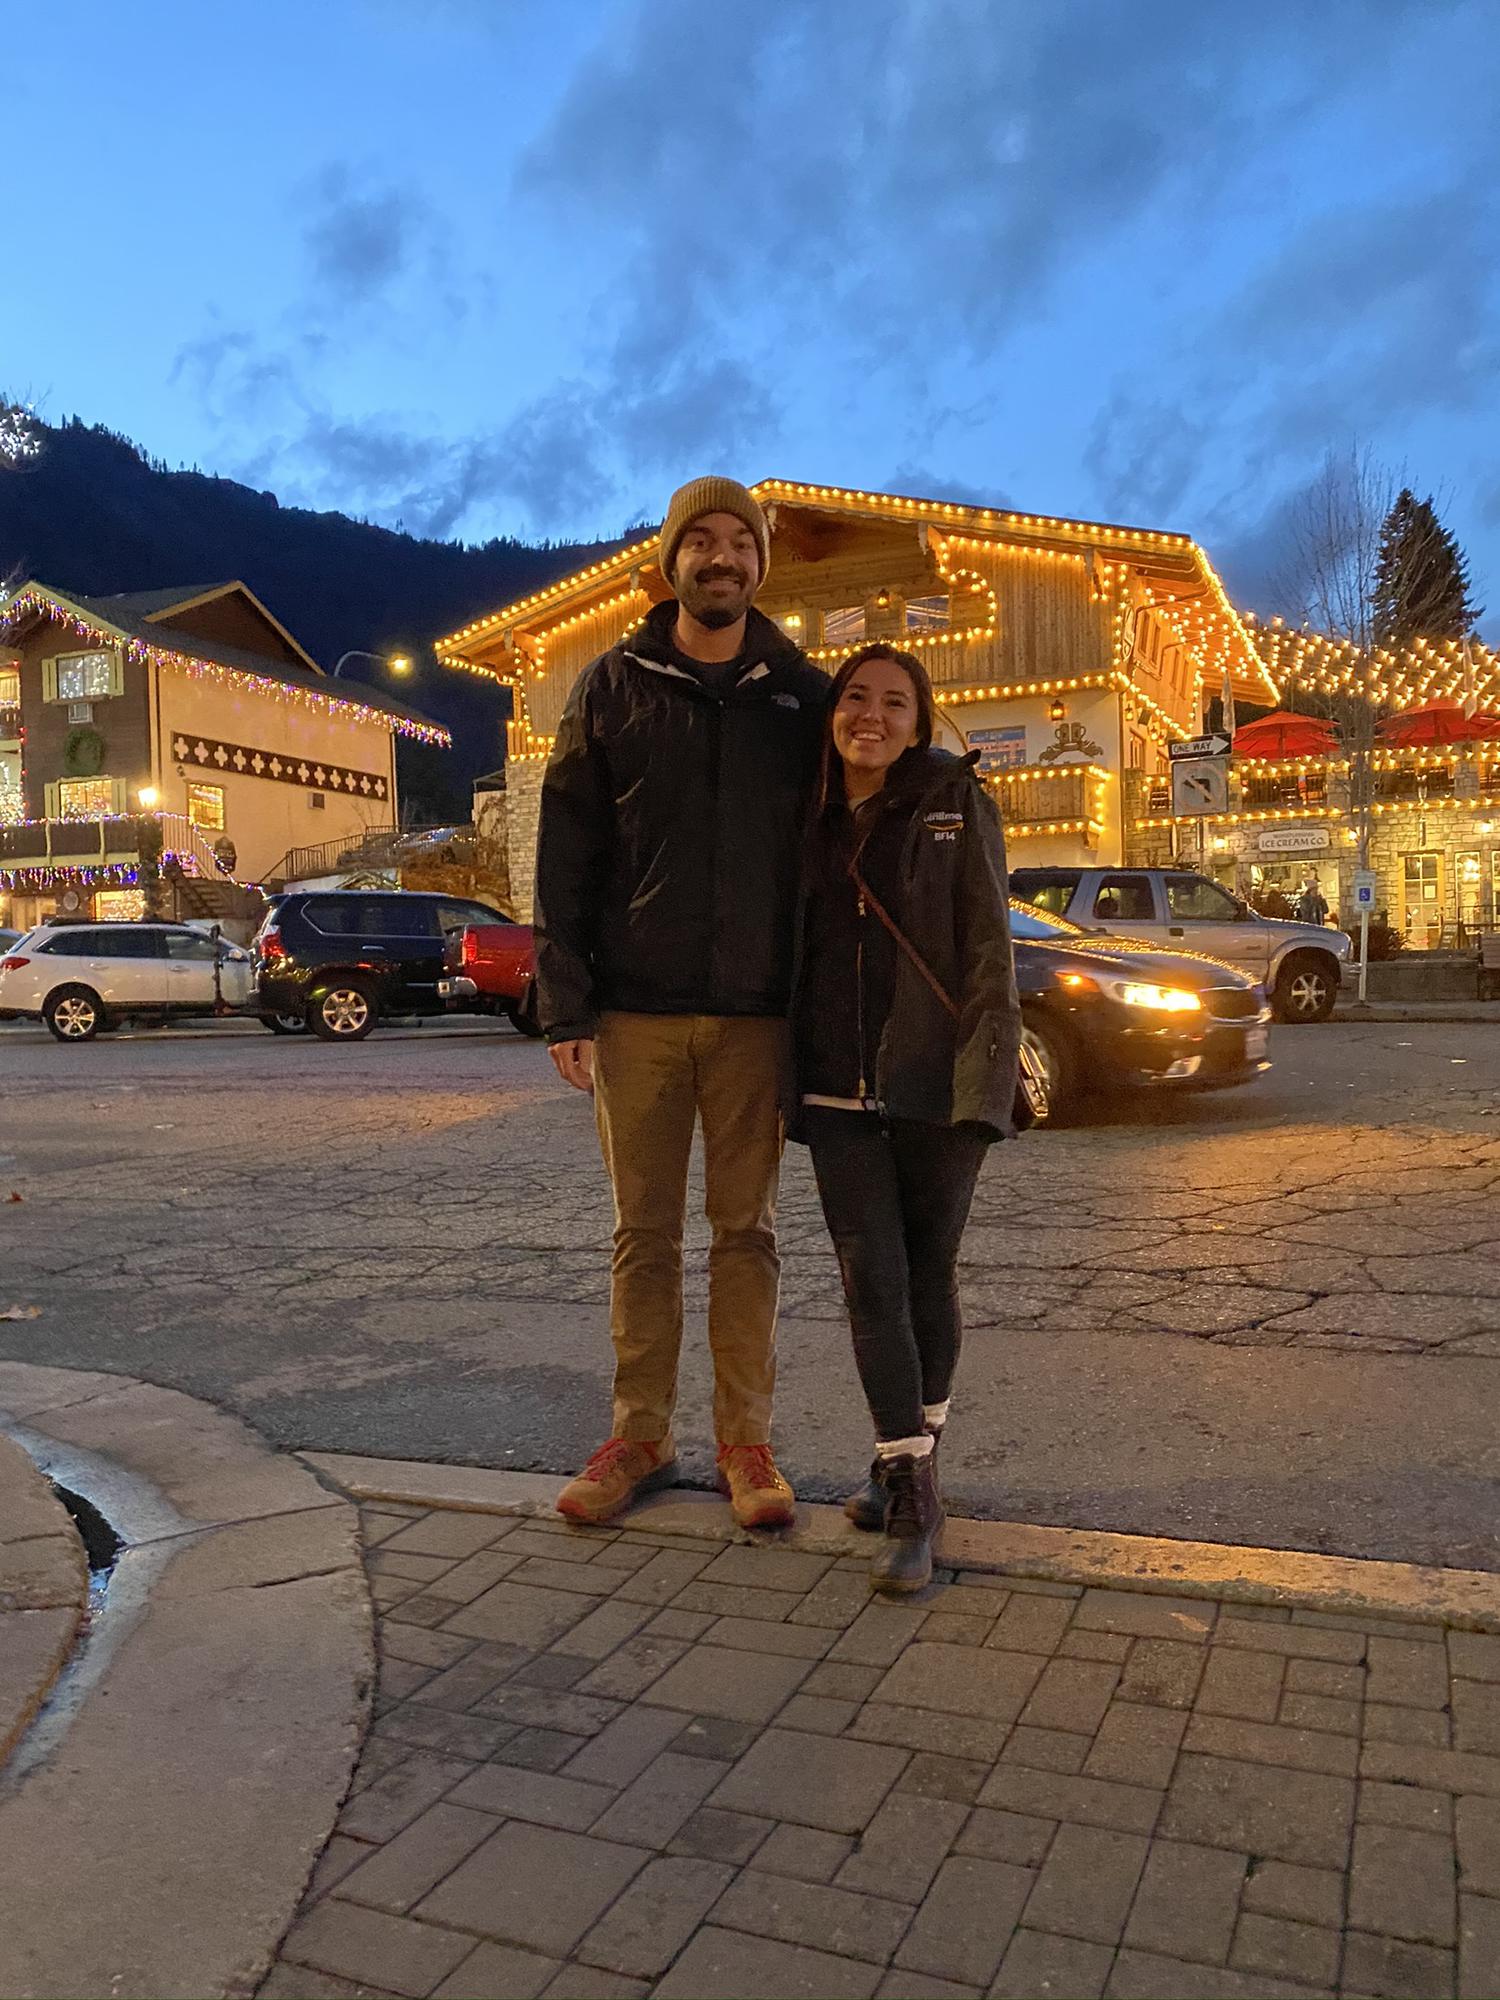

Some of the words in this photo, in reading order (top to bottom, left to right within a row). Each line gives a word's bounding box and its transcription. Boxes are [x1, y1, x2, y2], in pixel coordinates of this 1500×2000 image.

[1173, 743, 1190, 753] ONE
[1193, 741, 1211, 751] WAY
[1261, 840, 1276, 848] ICE
[1276, 837, 1309, 847] CREAM
